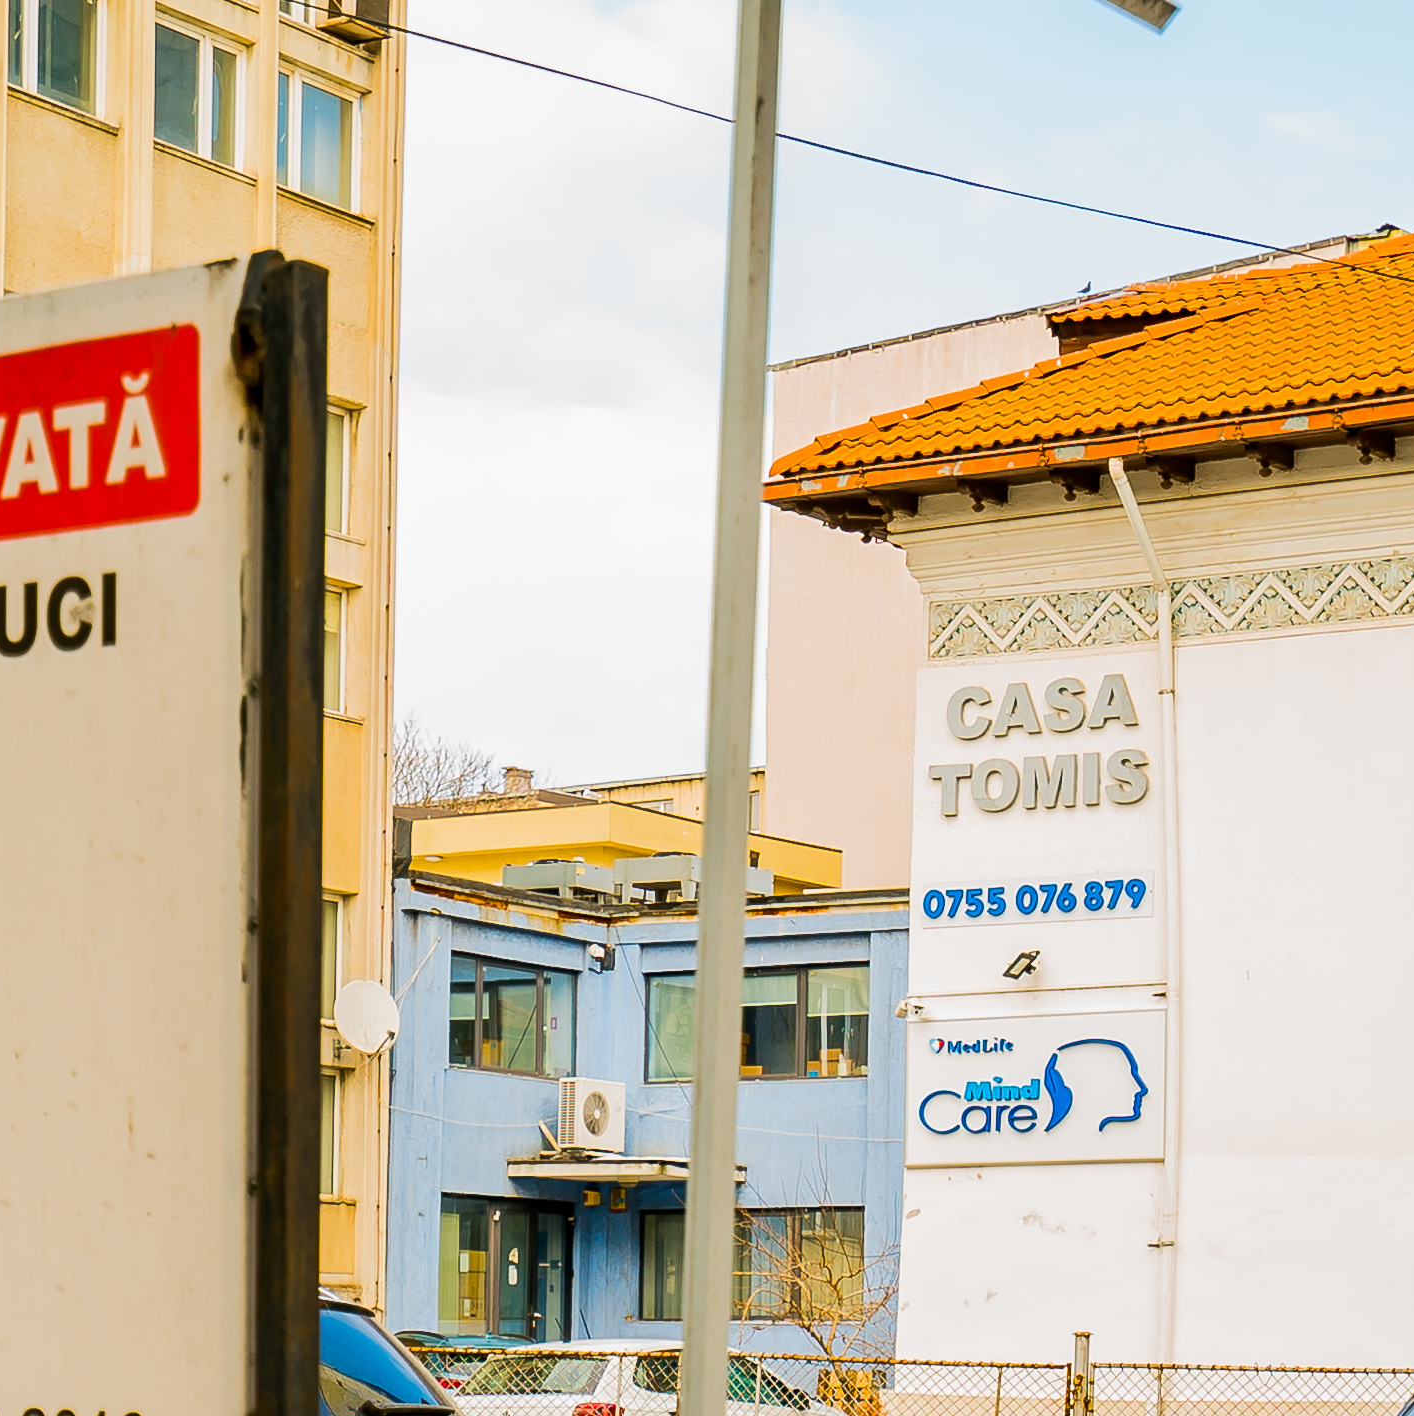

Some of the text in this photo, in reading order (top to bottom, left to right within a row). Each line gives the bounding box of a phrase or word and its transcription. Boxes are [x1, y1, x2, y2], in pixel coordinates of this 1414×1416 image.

[945, 672, 1141, 745] CASA
[927, 748, 1152, 819] TOMIS
[922, 878, 1147, 920] 0755 076 879
[946, 1036, 1015, 1055] MedLife
[963, 1075, 1041, 1102] Mind
[918, 1089, 1039, 1135] Care
